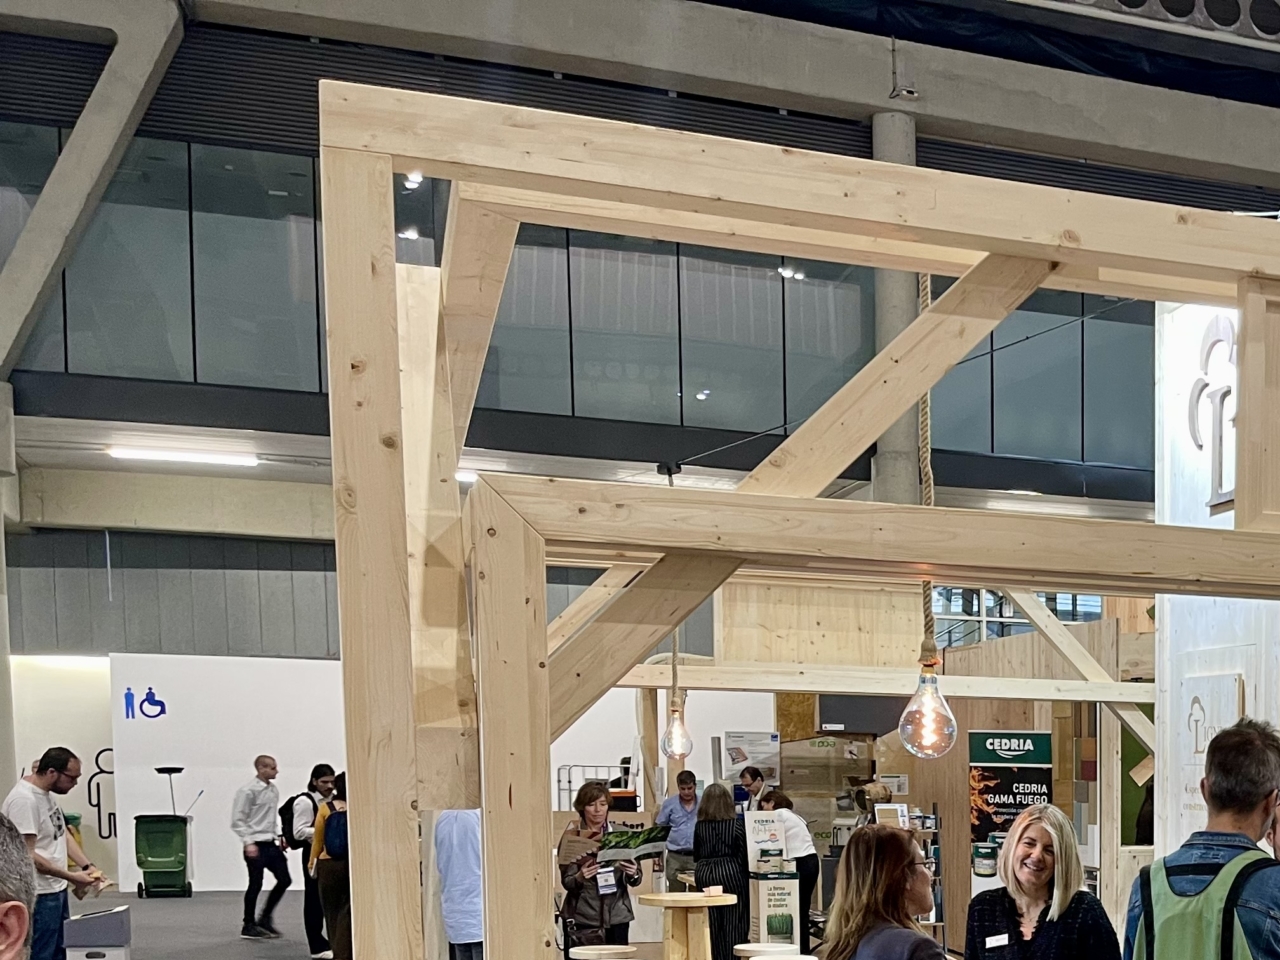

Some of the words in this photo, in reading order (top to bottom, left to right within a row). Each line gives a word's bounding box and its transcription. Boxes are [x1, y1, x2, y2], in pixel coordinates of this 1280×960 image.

[985, 738, 1035, 751] CEDRIA
[1013, 783, 1048, 794] CEDRIA
[987, 794, 1014, 804] GAMA
[1016, 795, 1048, 805] FUEGO
